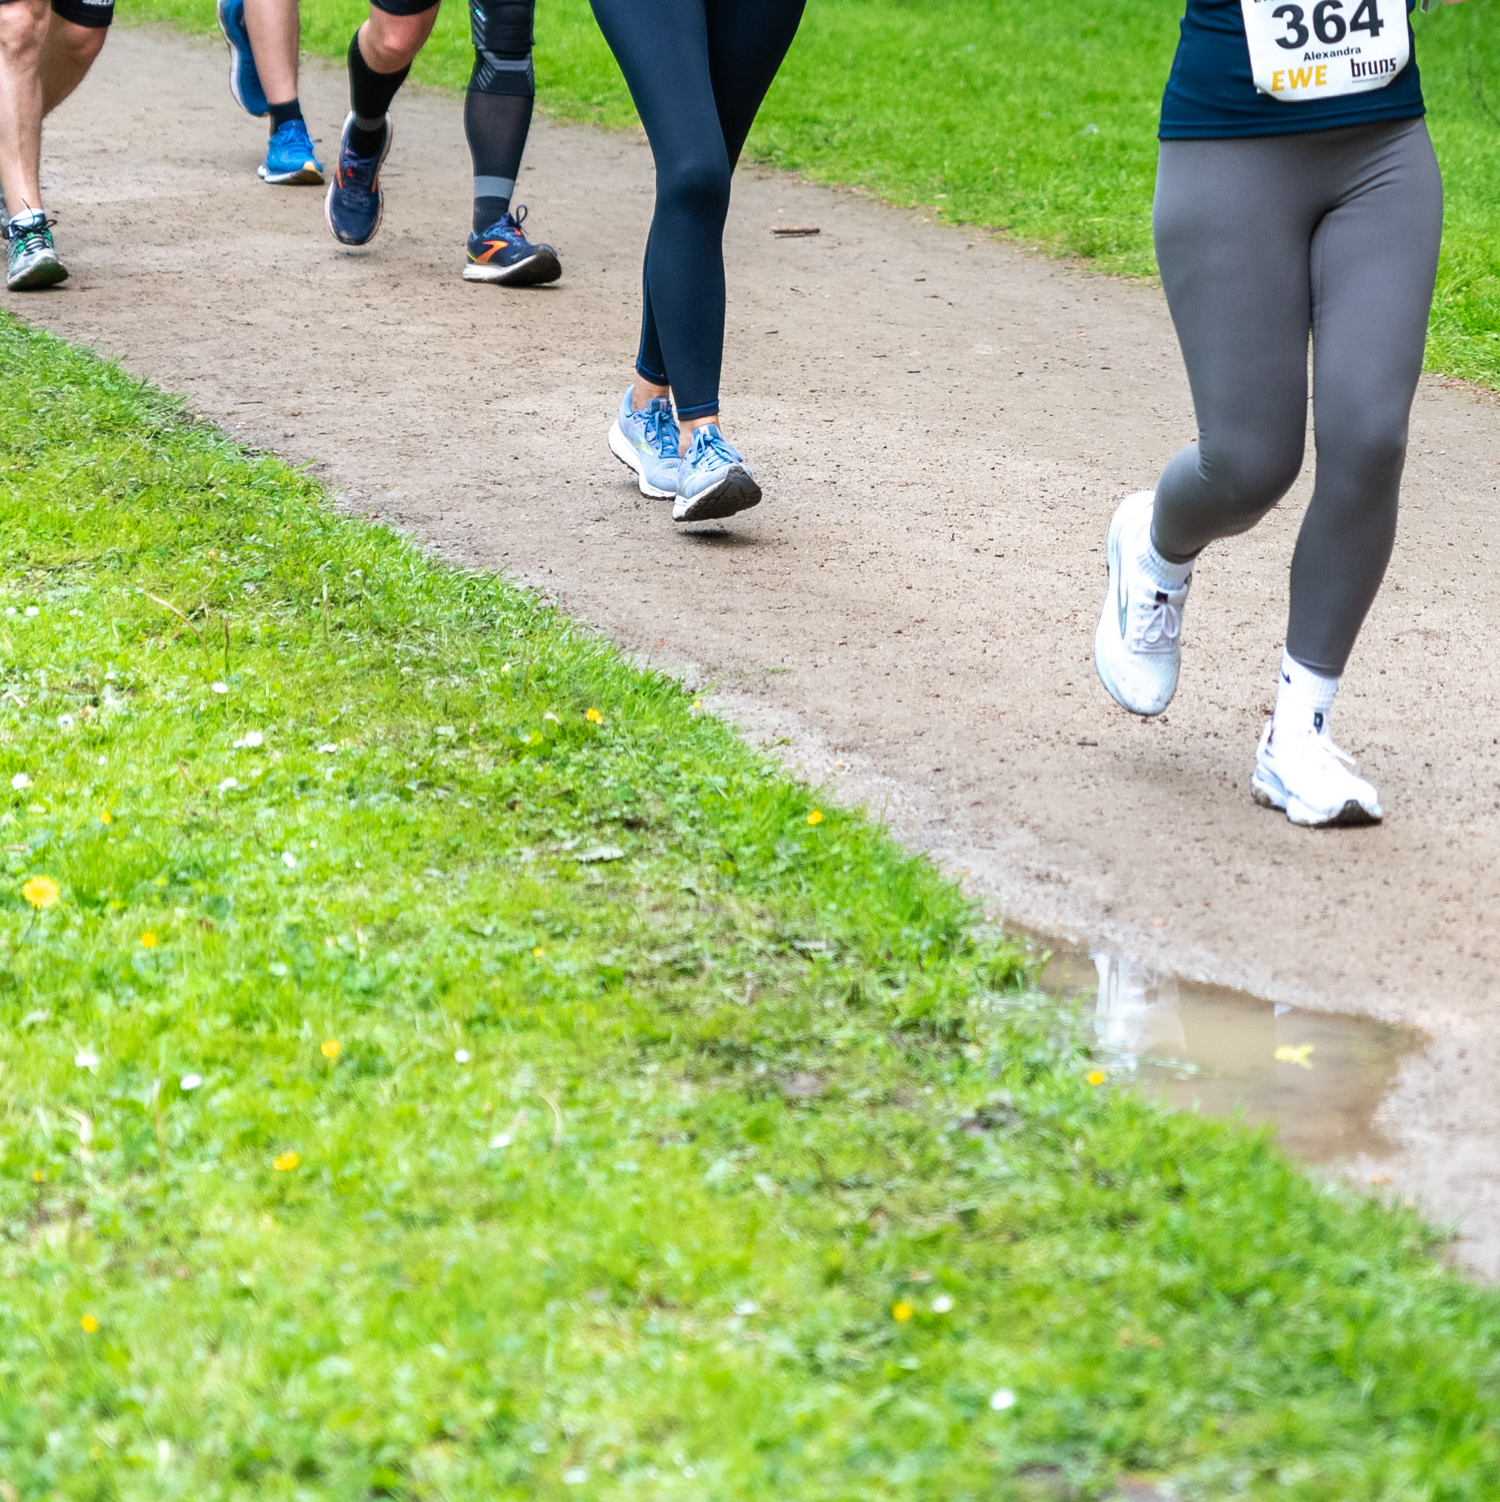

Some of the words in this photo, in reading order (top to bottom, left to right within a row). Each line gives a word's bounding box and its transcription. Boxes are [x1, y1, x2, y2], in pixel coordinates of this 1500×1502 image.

[1303, 46, 1361, 61] Alexandra
[1350, 57, 1397, 77] bruns
[1271, 64, 1328, 92] EWE
